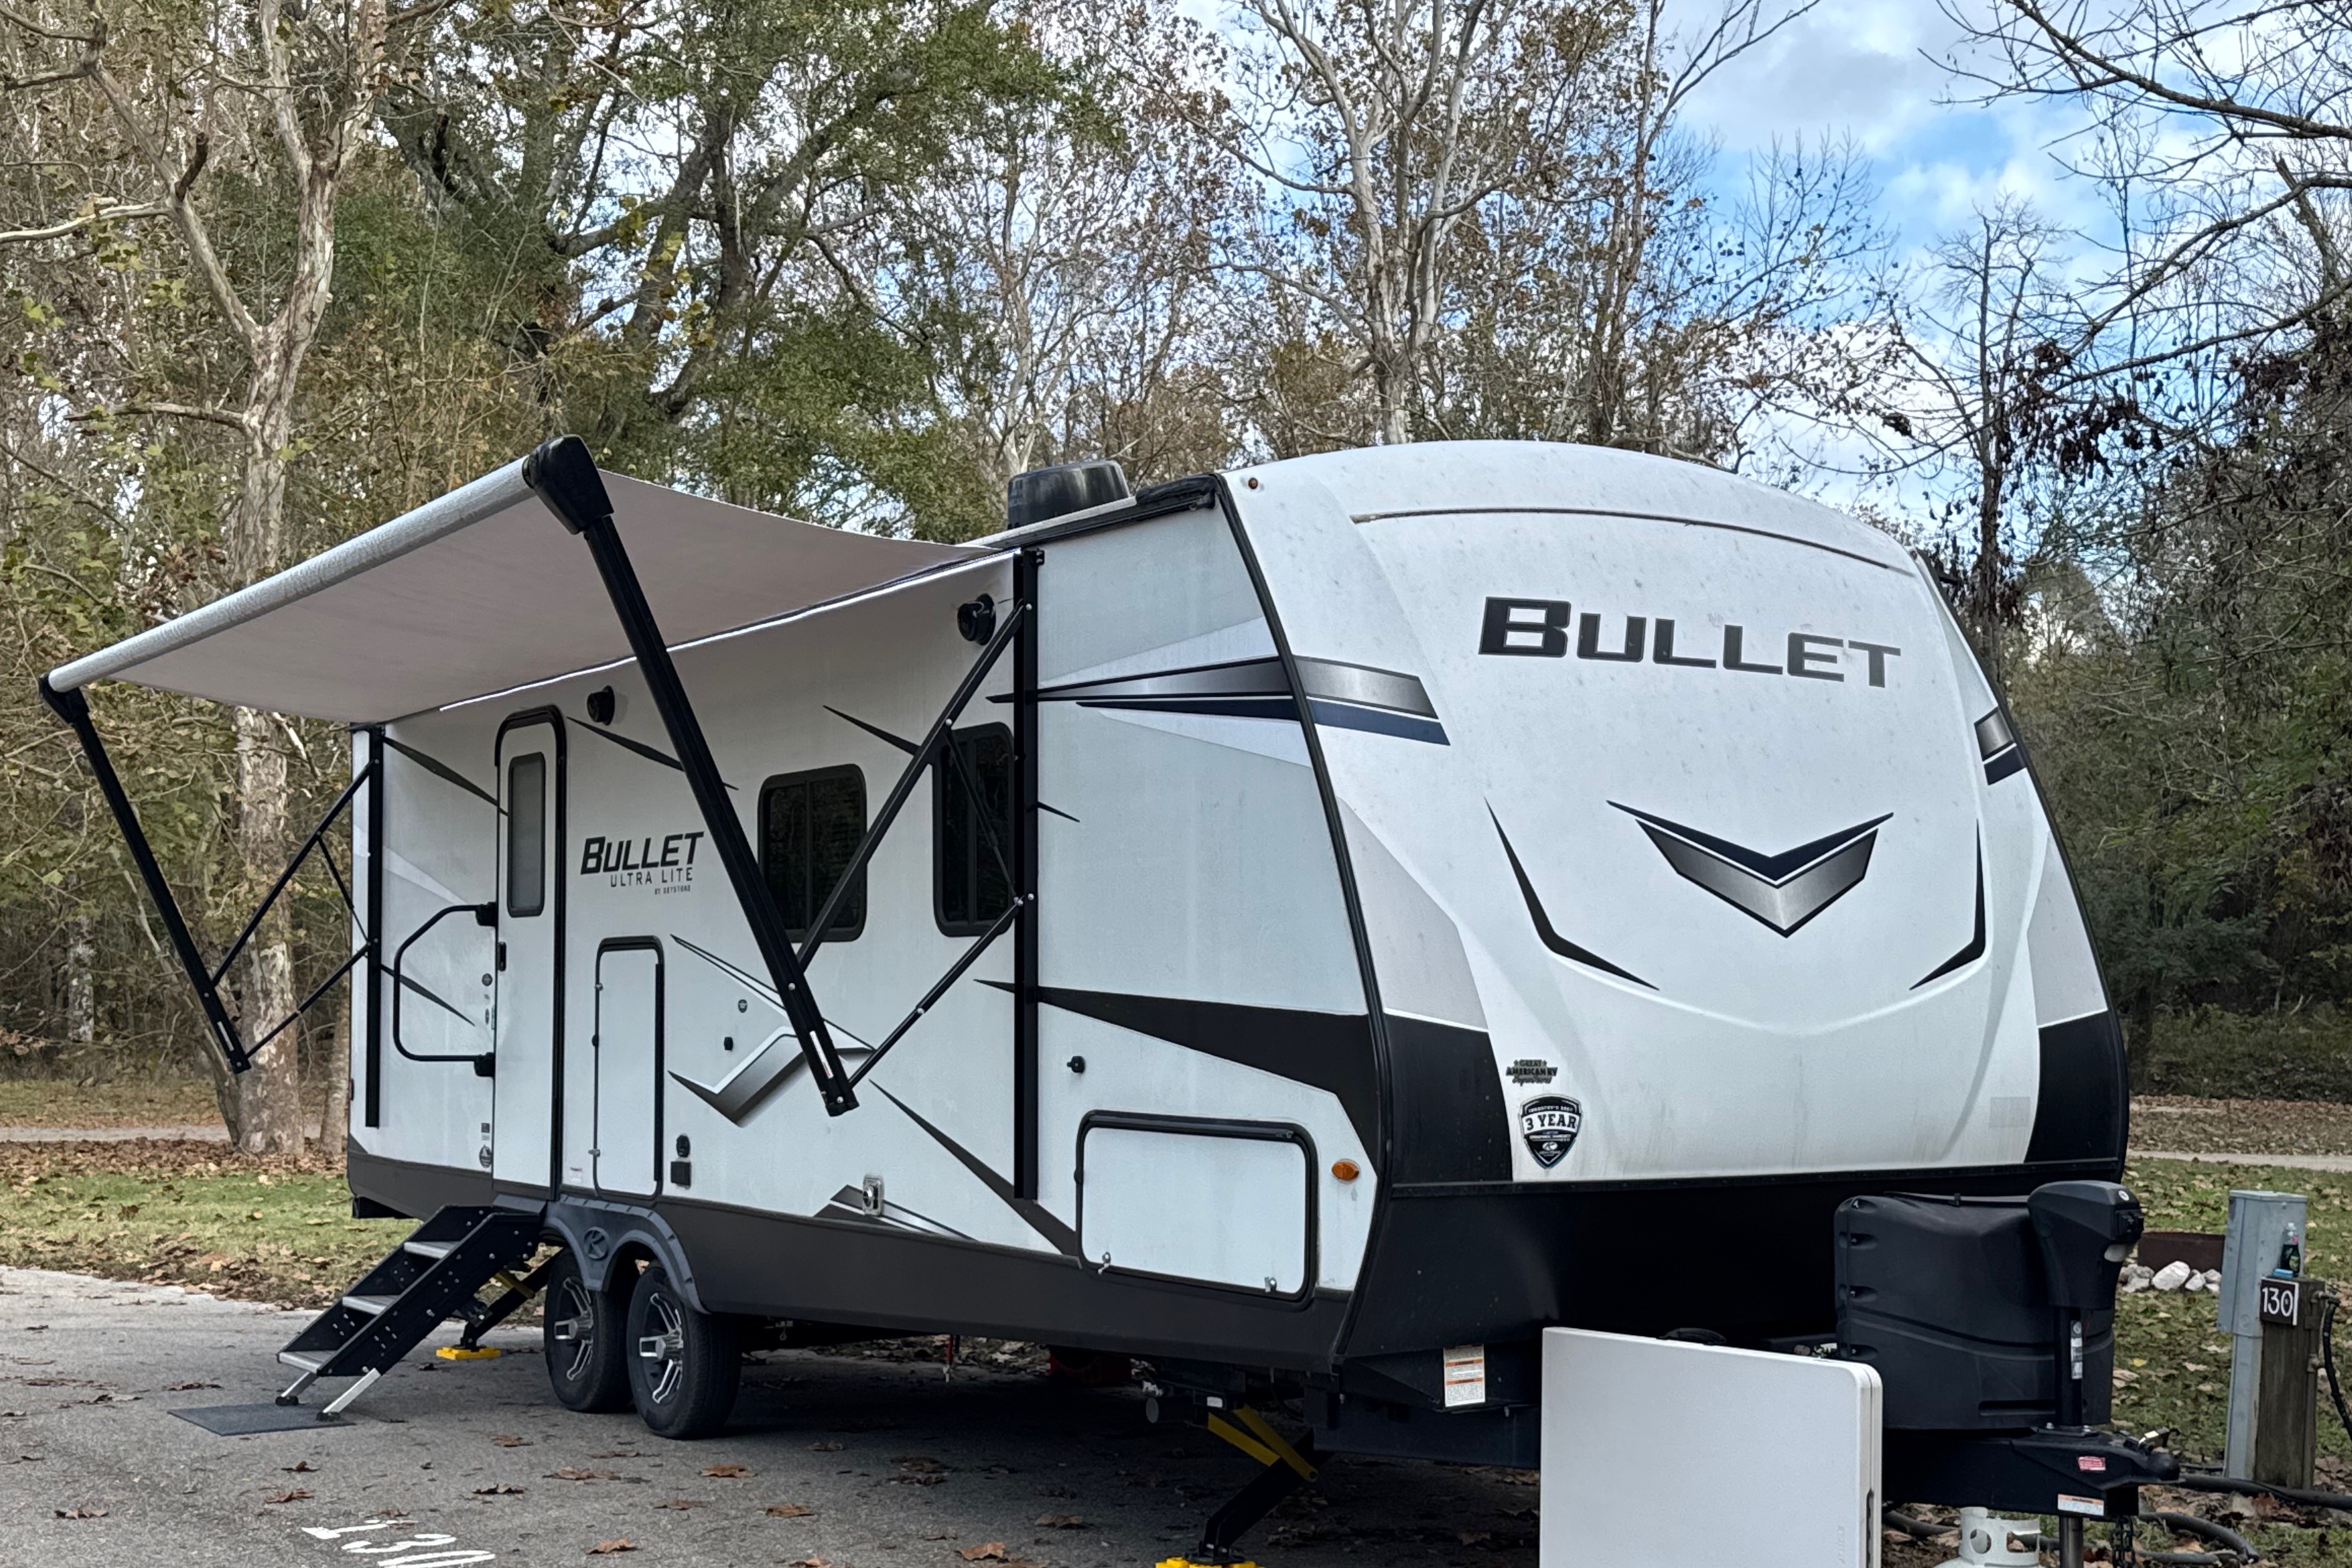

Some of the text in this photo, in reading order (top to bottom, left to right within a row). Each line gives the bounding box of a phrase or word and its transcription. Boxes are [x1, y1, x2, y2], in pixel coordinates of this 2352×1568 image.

[1478, 596, 1902, 688] BULLET
[581, 832, 704, 874] BULLET
[610, 867, 693, 887] ULTRA LITE
[1525, 1114, 1576, 1131] 3 YEAR
[2262, 1287, 2293, 1316] 130
